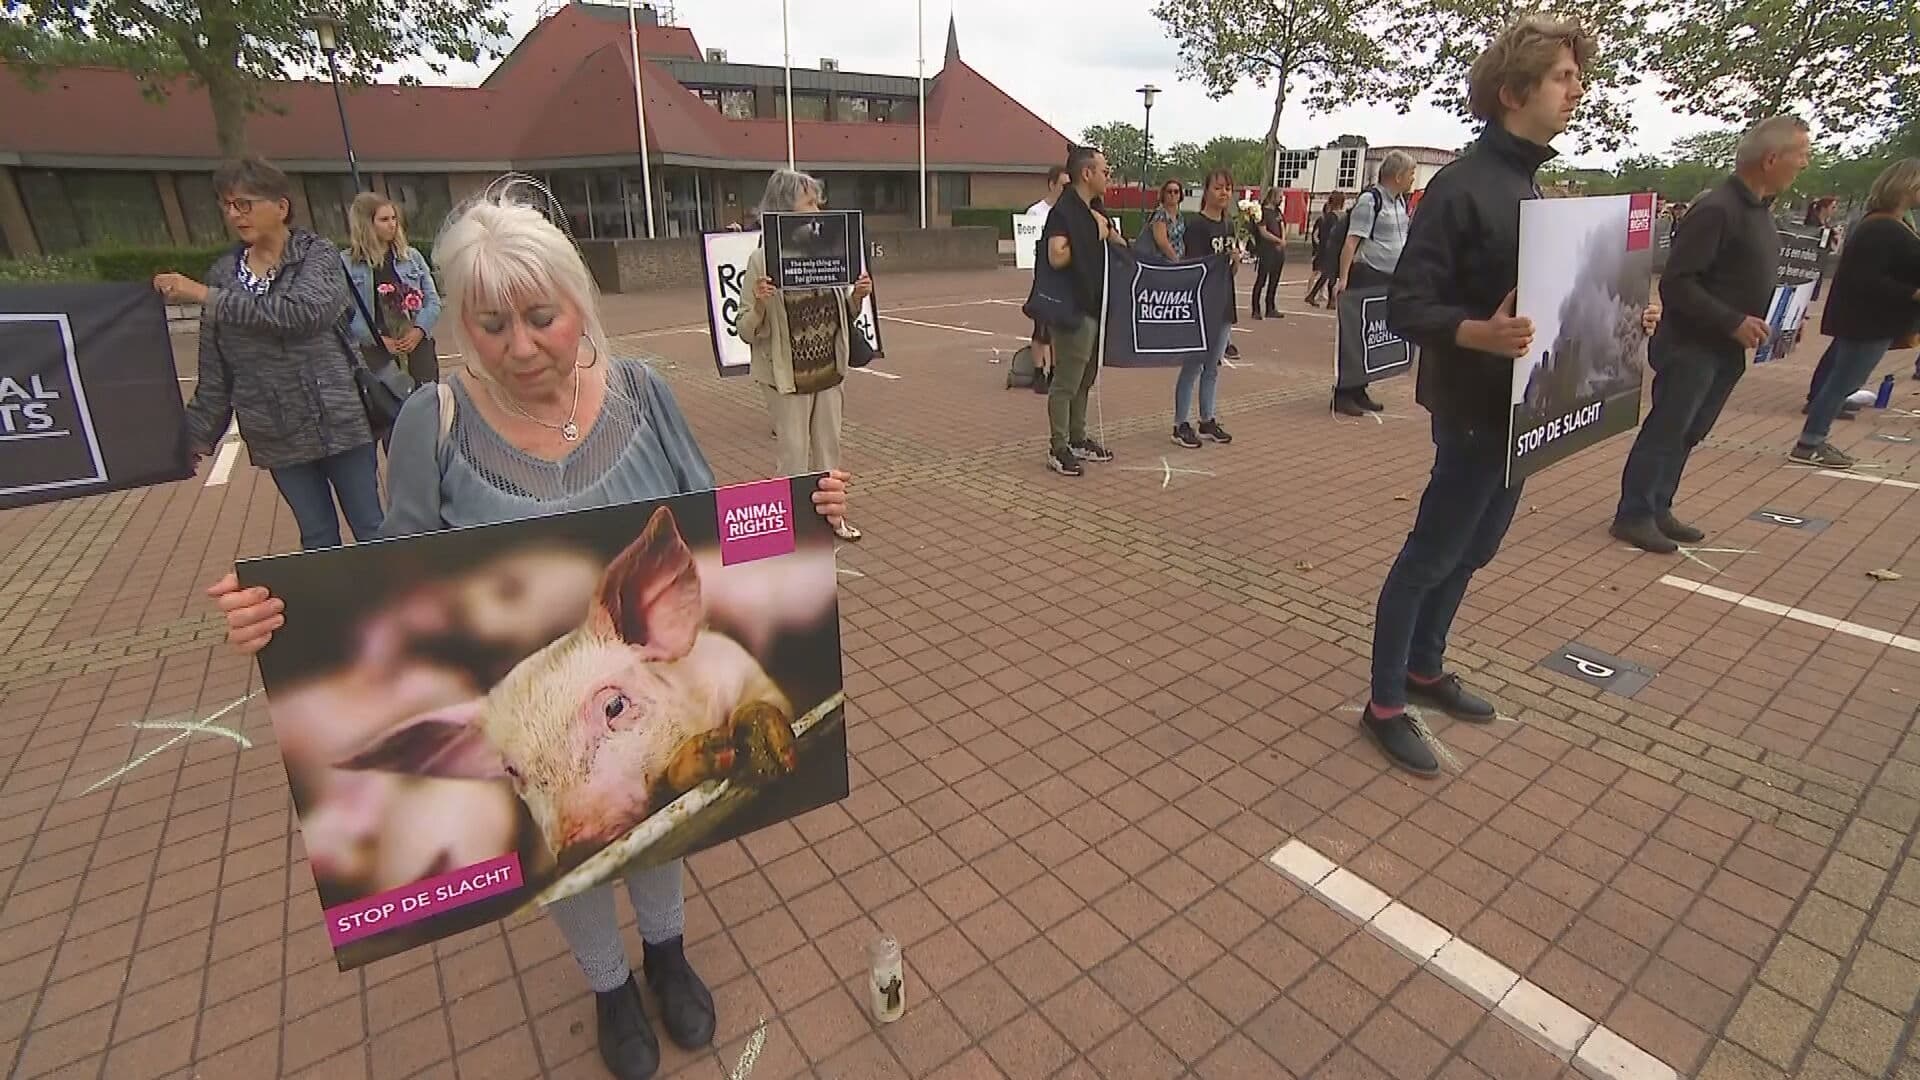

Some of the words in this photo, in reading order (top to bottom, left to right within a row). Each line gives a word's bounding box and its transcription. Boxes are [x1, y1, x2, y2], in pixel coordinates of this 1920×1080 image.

[784, 267, 803, 275] NEED
[817, 265, 840, 273] animals
[802, 258, 815, 269] only
[815, 258, 832, 268] thing
[1137, 288, 1194, 305] ANIMAL
[1141, 304, 1191, 319] RIGHTS
[1516, 425, 1545, 457] STOP
[1546, 417, 1562, 442] DE
[1562, 401, 1602, 435] SLACHT
[724, 501, 787, 524] ANIMAL
[729, 515, 784, 537] RIGHTS
[337, 903, 395, 932] STOP
[401, 892, 431, 912] DE
[435, 866, 512, 901] SLACHT
